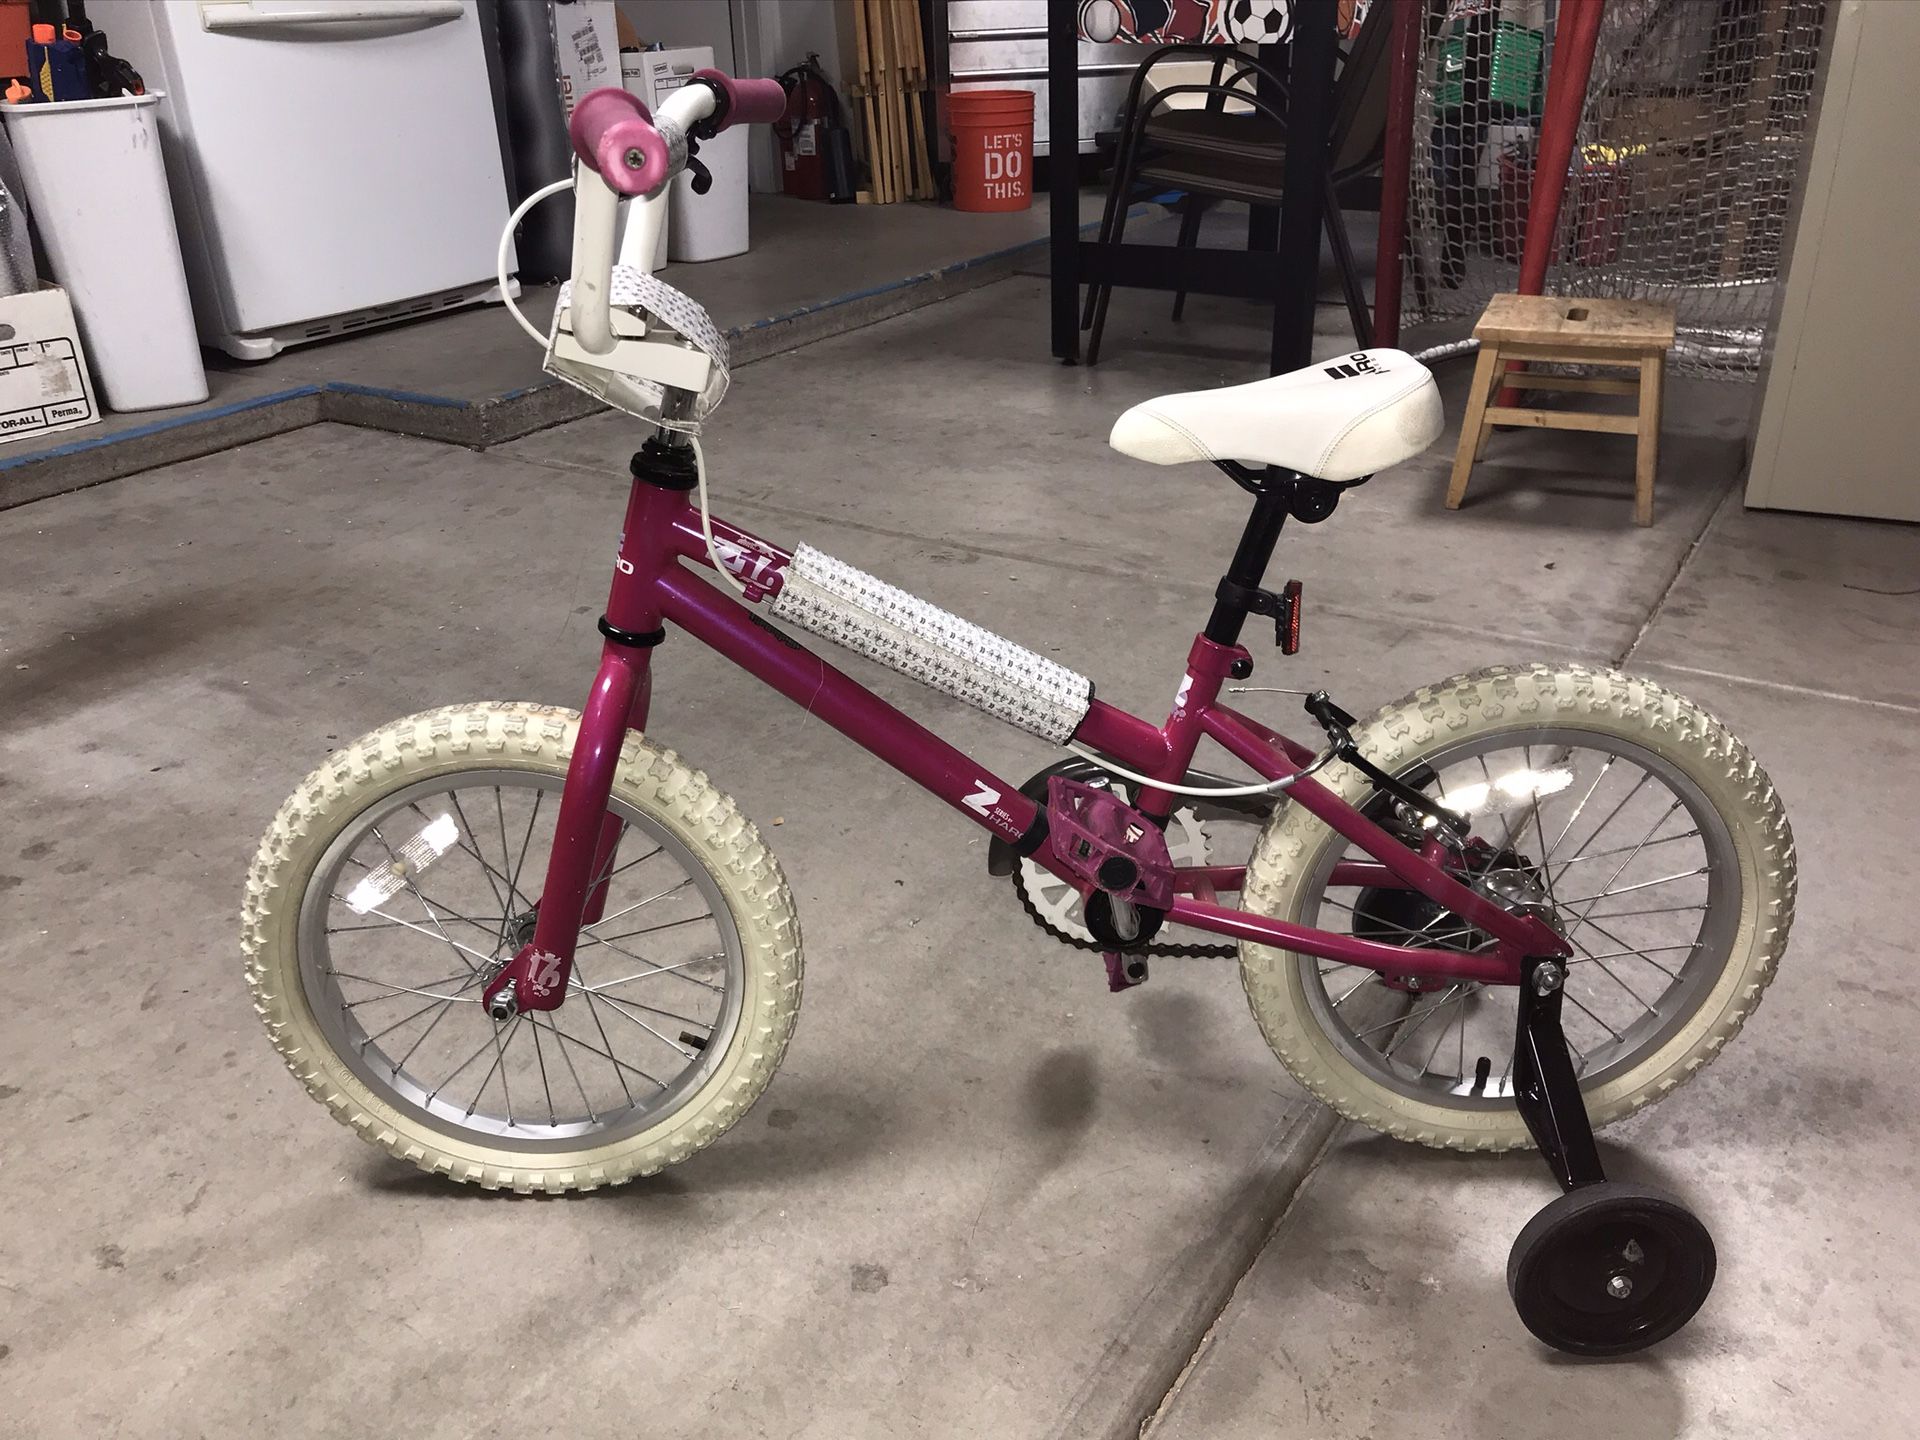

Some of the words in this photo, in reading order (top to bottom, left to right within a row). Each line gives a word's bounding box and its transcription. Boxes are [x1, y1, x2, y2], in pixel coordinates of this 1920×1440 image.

[984, 133, 1022, 149] LET'S
[984, 151, 1022, 179] DO
[984, 181, 1025, 199] THIS.
[961, 779, 1002, 818] Z
